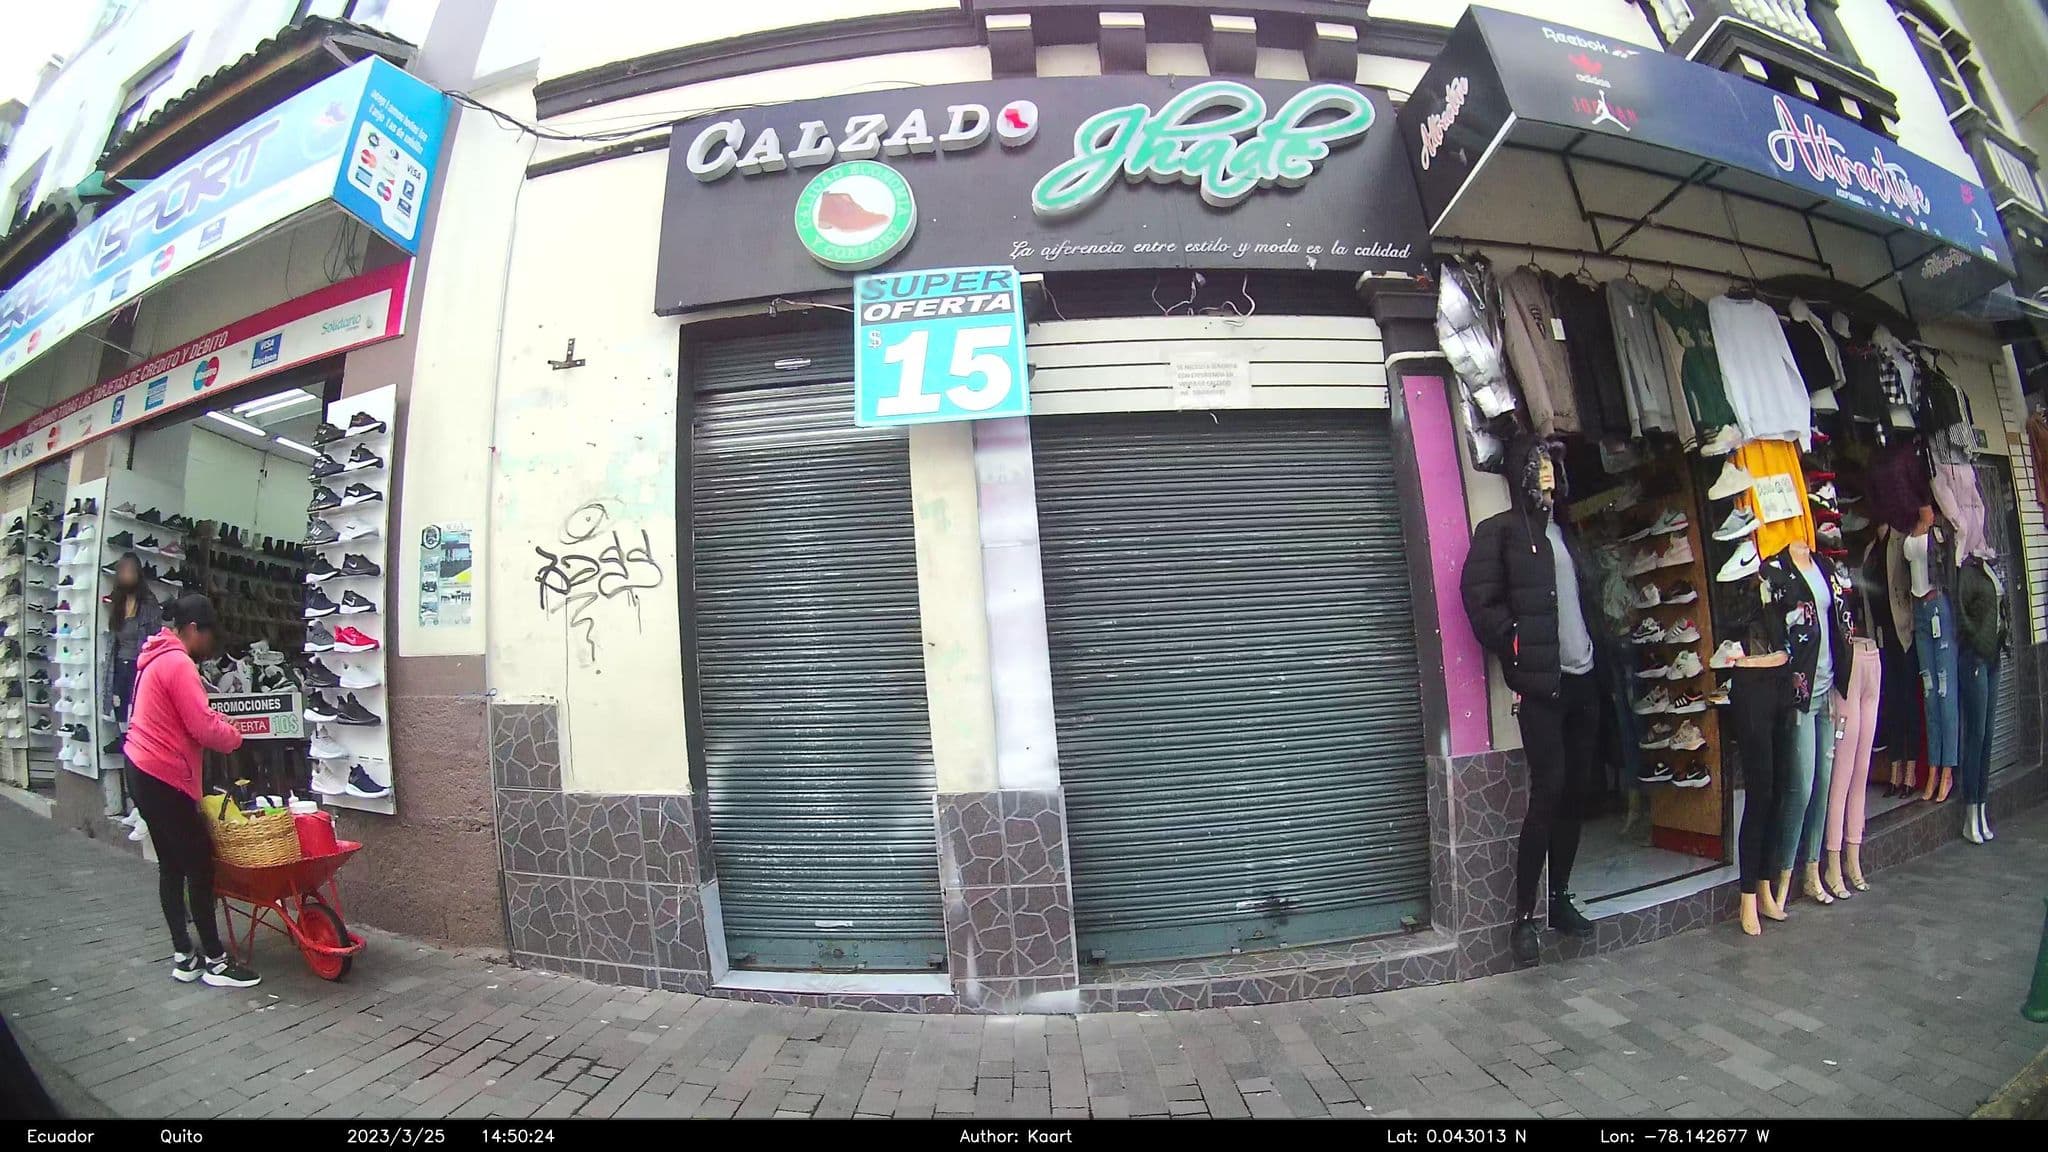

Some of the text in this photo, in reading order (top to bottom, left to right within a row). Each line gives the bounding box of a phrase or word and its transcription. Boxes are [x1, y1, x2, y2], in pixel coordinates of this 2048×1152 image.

[1541, 27, 1609, 54] Reebok
[686, 100, 1039, 183] CALZADO
[407, 164, 422, 181] VISA
[1009, 240, 1036, 260] La
[1133, 240, 1178, 254] entre
[1185, 236, 1231, 254] estilo
[1232, 240, 1252, 258] y
[1254, 238, 1300, 254] moda
[1306, 243, 1324, 254] es
[1331, 239, 1349, 255] la
[1354, 241, 1411, 258] calidad
[860, 269, 1013, 301] SUPER
[863, 293, 1012, 322] OFERTA
[181, 346, 191, 364] Y
[869, 325, 1013, 416] $ 15
[211, 698, 281, 713] PROMOCIONES
[241, 719, 267, 732] ERTA
